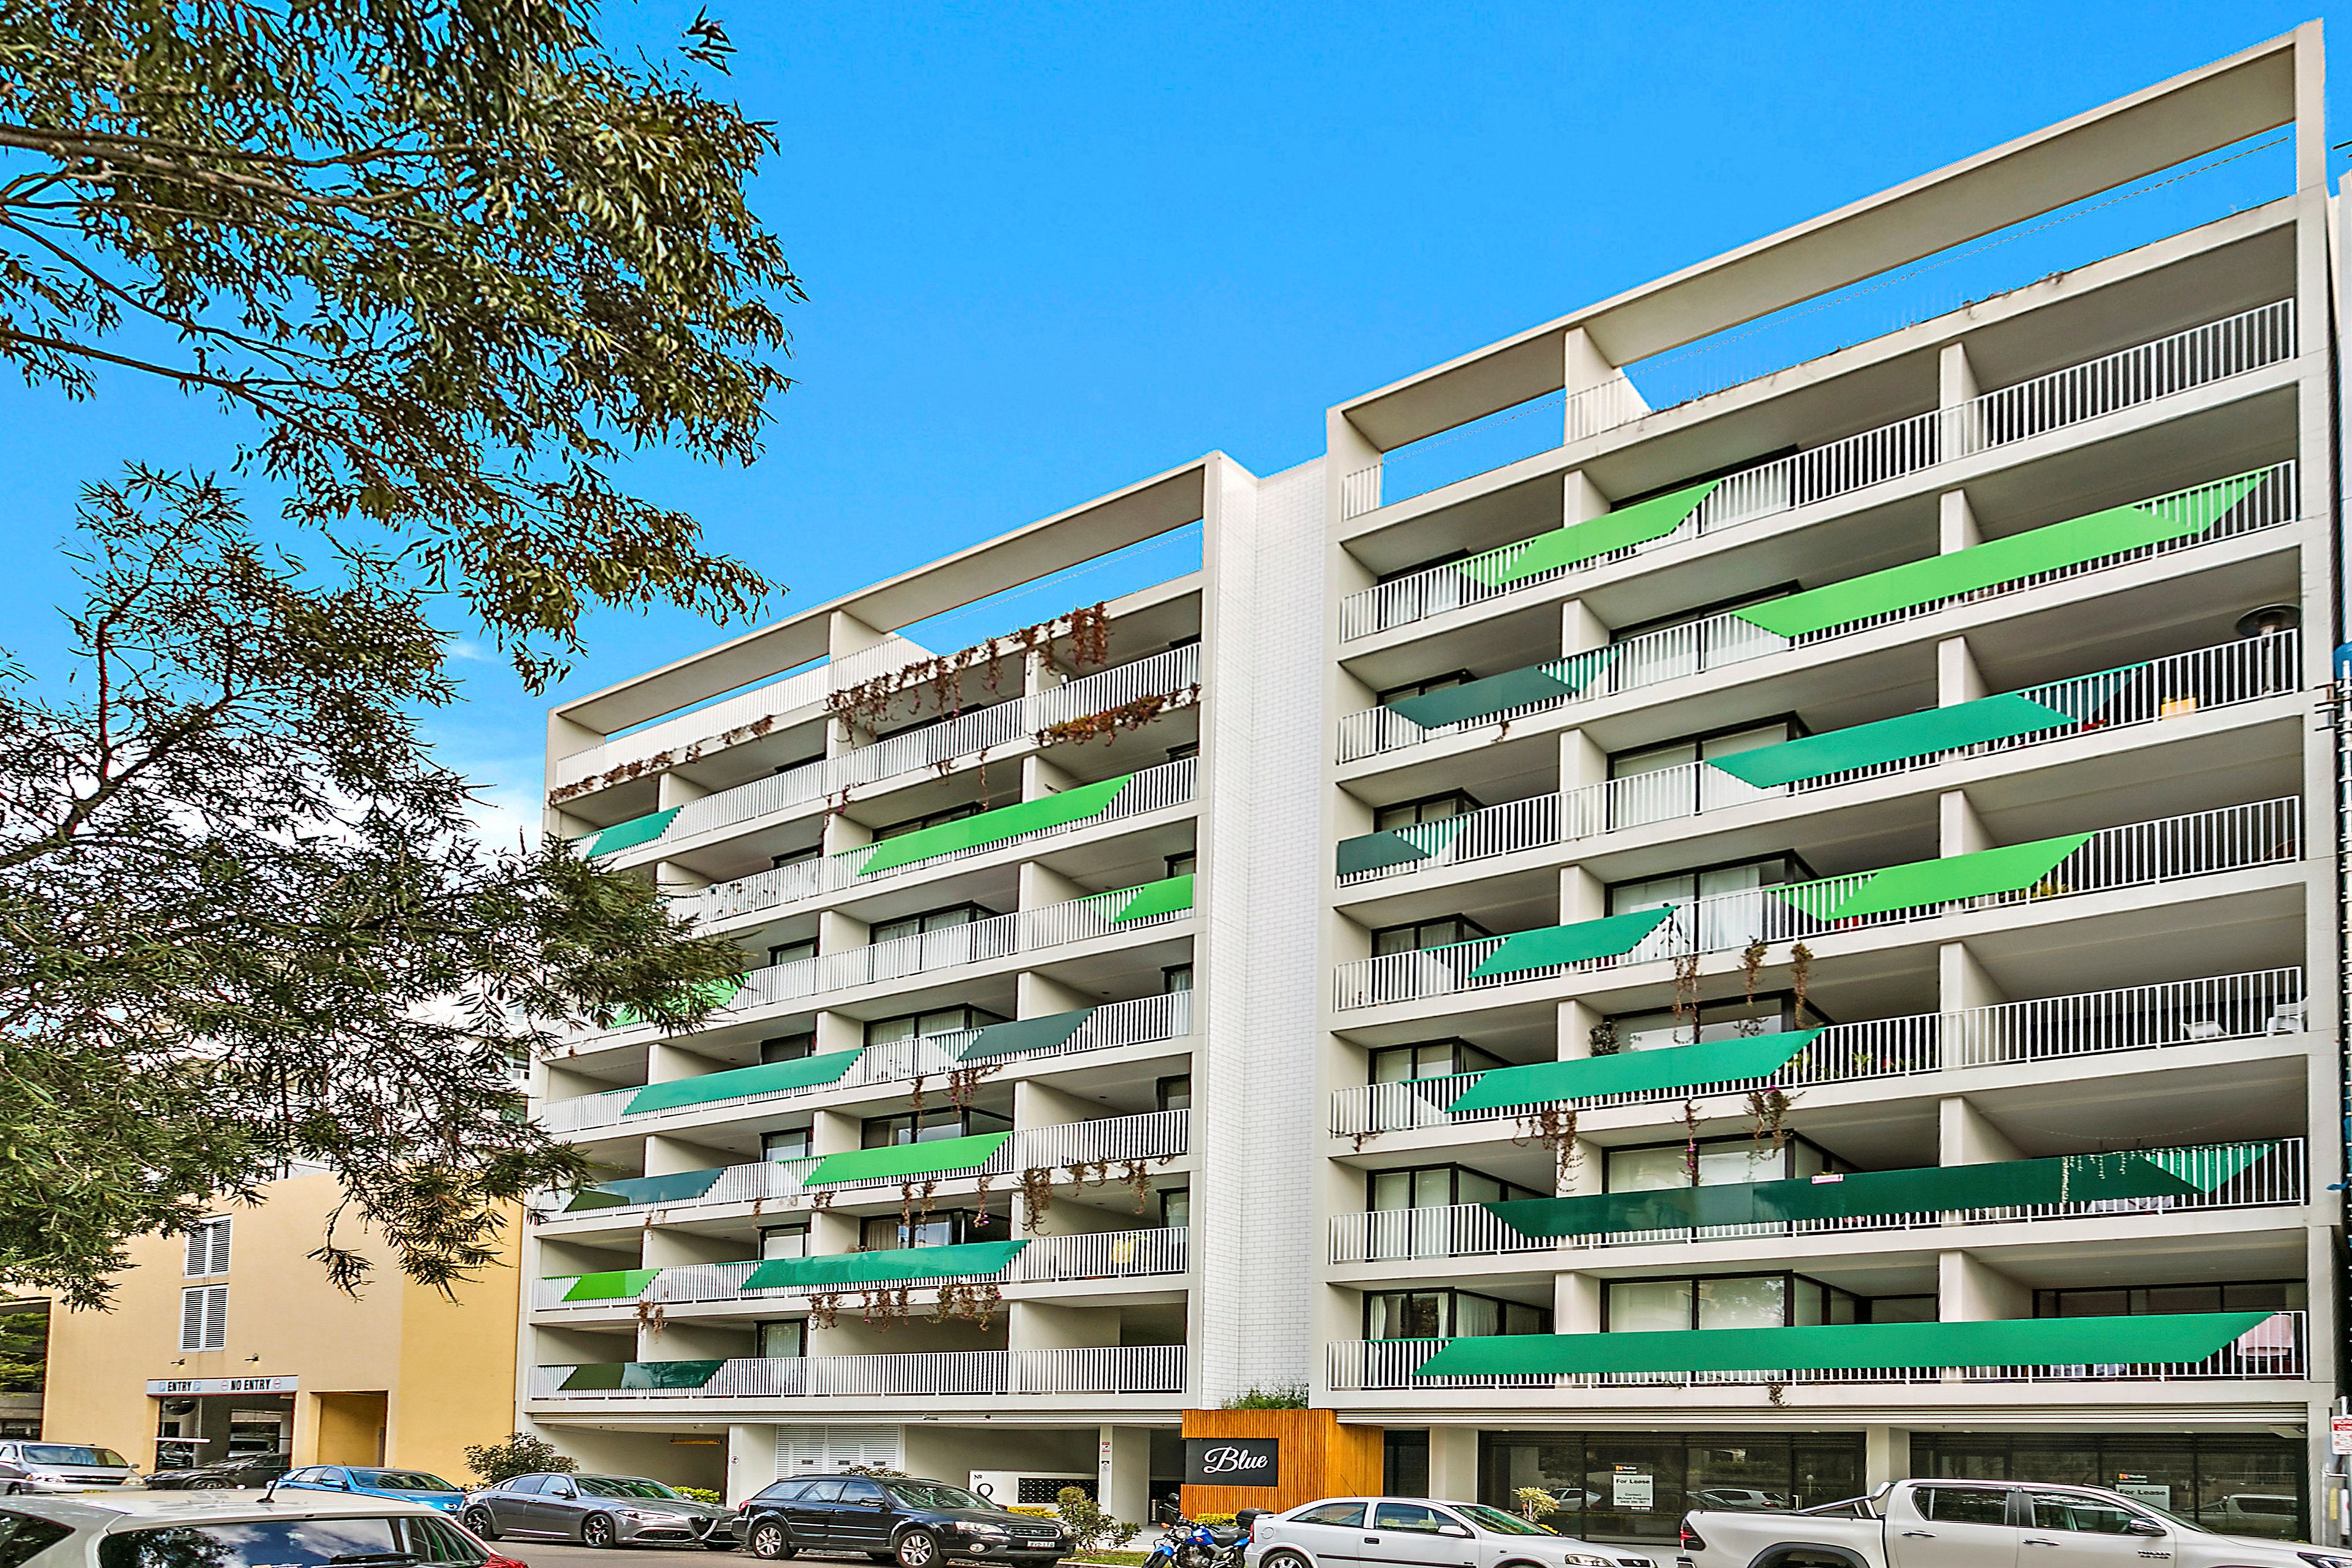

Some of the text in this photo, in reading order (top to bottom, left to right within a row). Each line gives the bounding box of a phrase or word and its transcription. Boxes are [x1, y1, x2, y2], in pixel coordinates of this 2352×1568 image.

[167, 1381, 192, 1392] ENTRY
[230, 1379, 271, 1390] NO ENTRY
[1203, 1446, 1268, 1474] Blue
